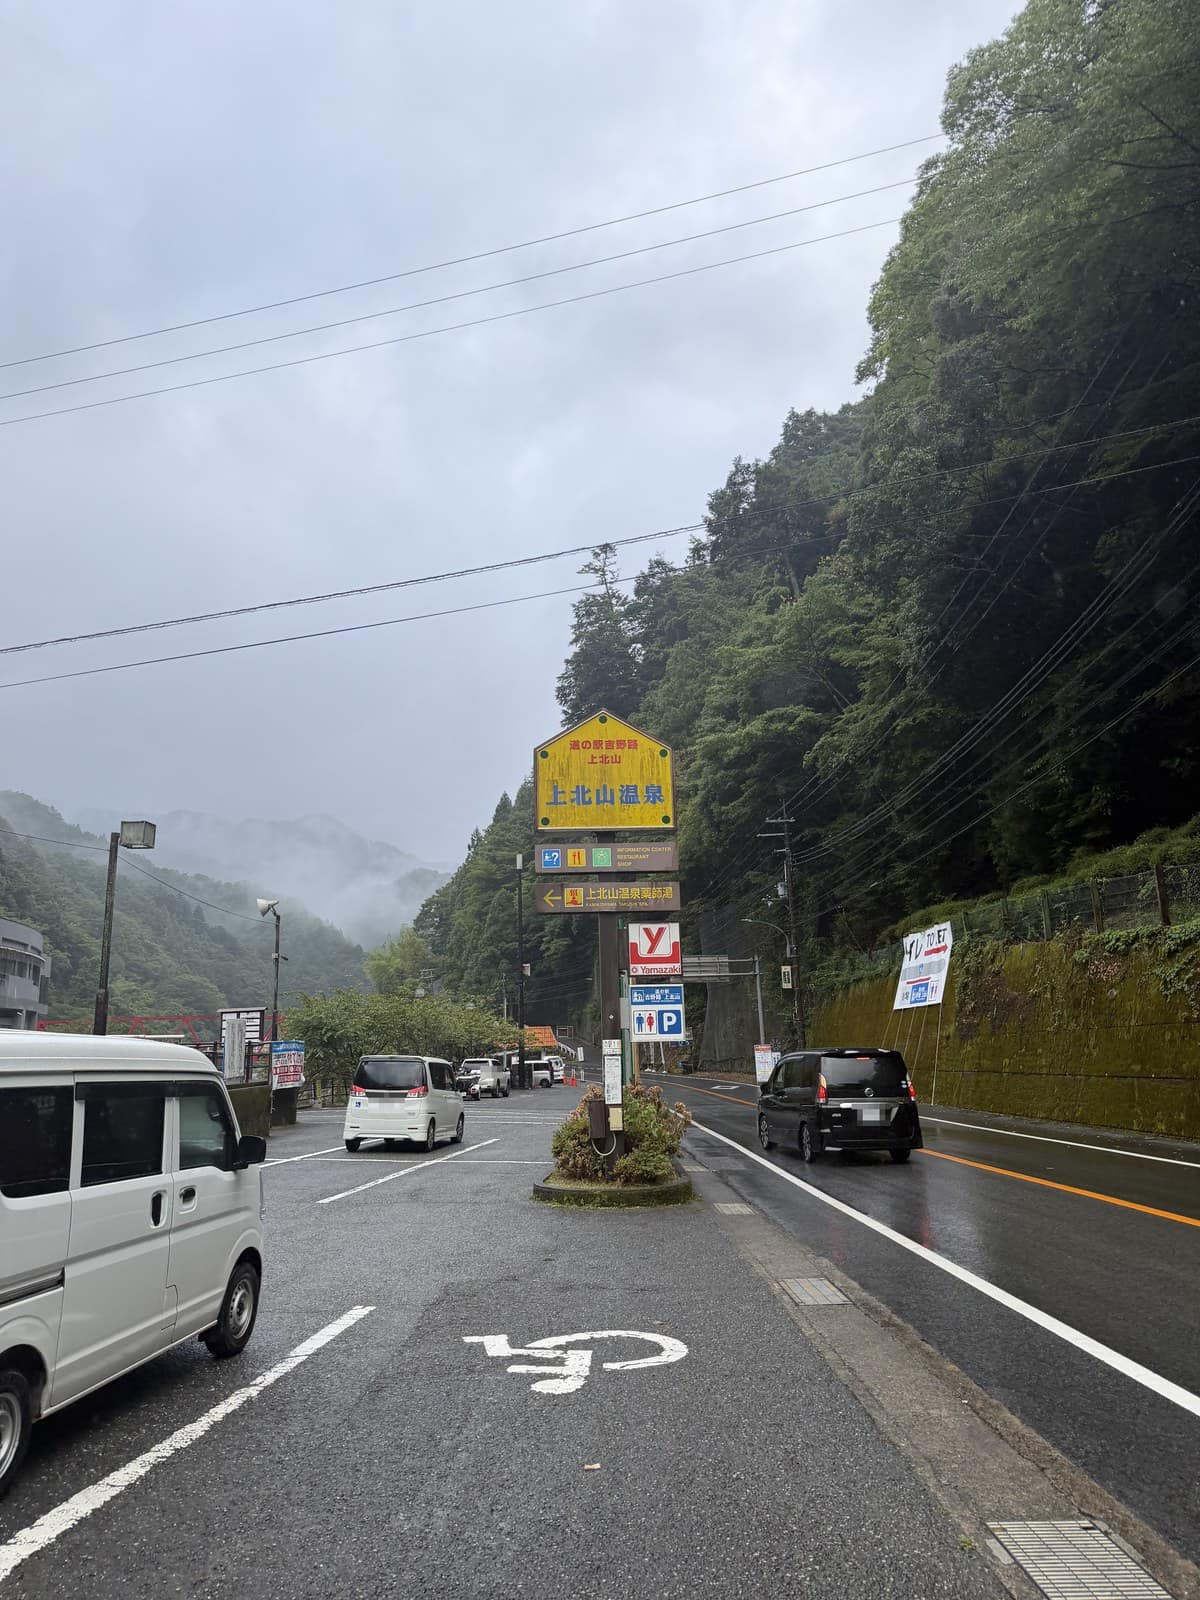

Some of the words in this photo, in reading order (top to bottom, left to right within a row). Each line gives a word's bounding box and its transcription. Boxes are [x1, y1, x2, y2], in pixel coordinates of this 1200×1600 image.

[569, 740, 639, 751] 道の駅吉野路
[588, 754, 622, 765] 上北山
[546, 784, 665, 806] 上北山温泉
[585, 887, 673, 900] 上北山温泉薬師湯
[640, 965, 681, 974] Yamazaki
[663, 1012, 677, 1032] P
